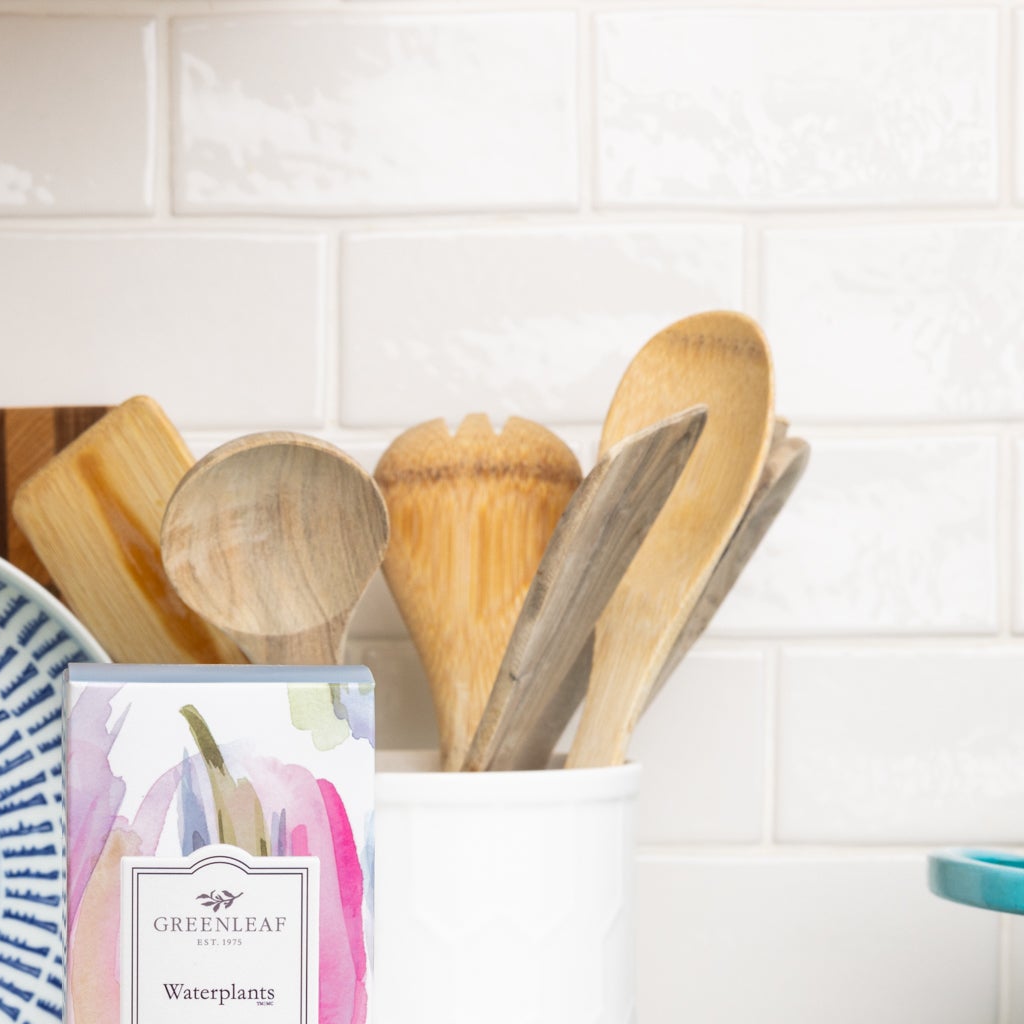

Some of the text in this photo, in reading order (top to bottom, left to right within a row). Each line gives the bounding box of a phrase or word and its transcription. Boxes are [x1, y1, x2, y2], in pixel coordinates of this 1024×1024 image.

[153, 916, 287, 932] GREENLEAF
[196, 938, 243, 946] EST. 1975
[163, 983, 275, 1005] Waterplants
